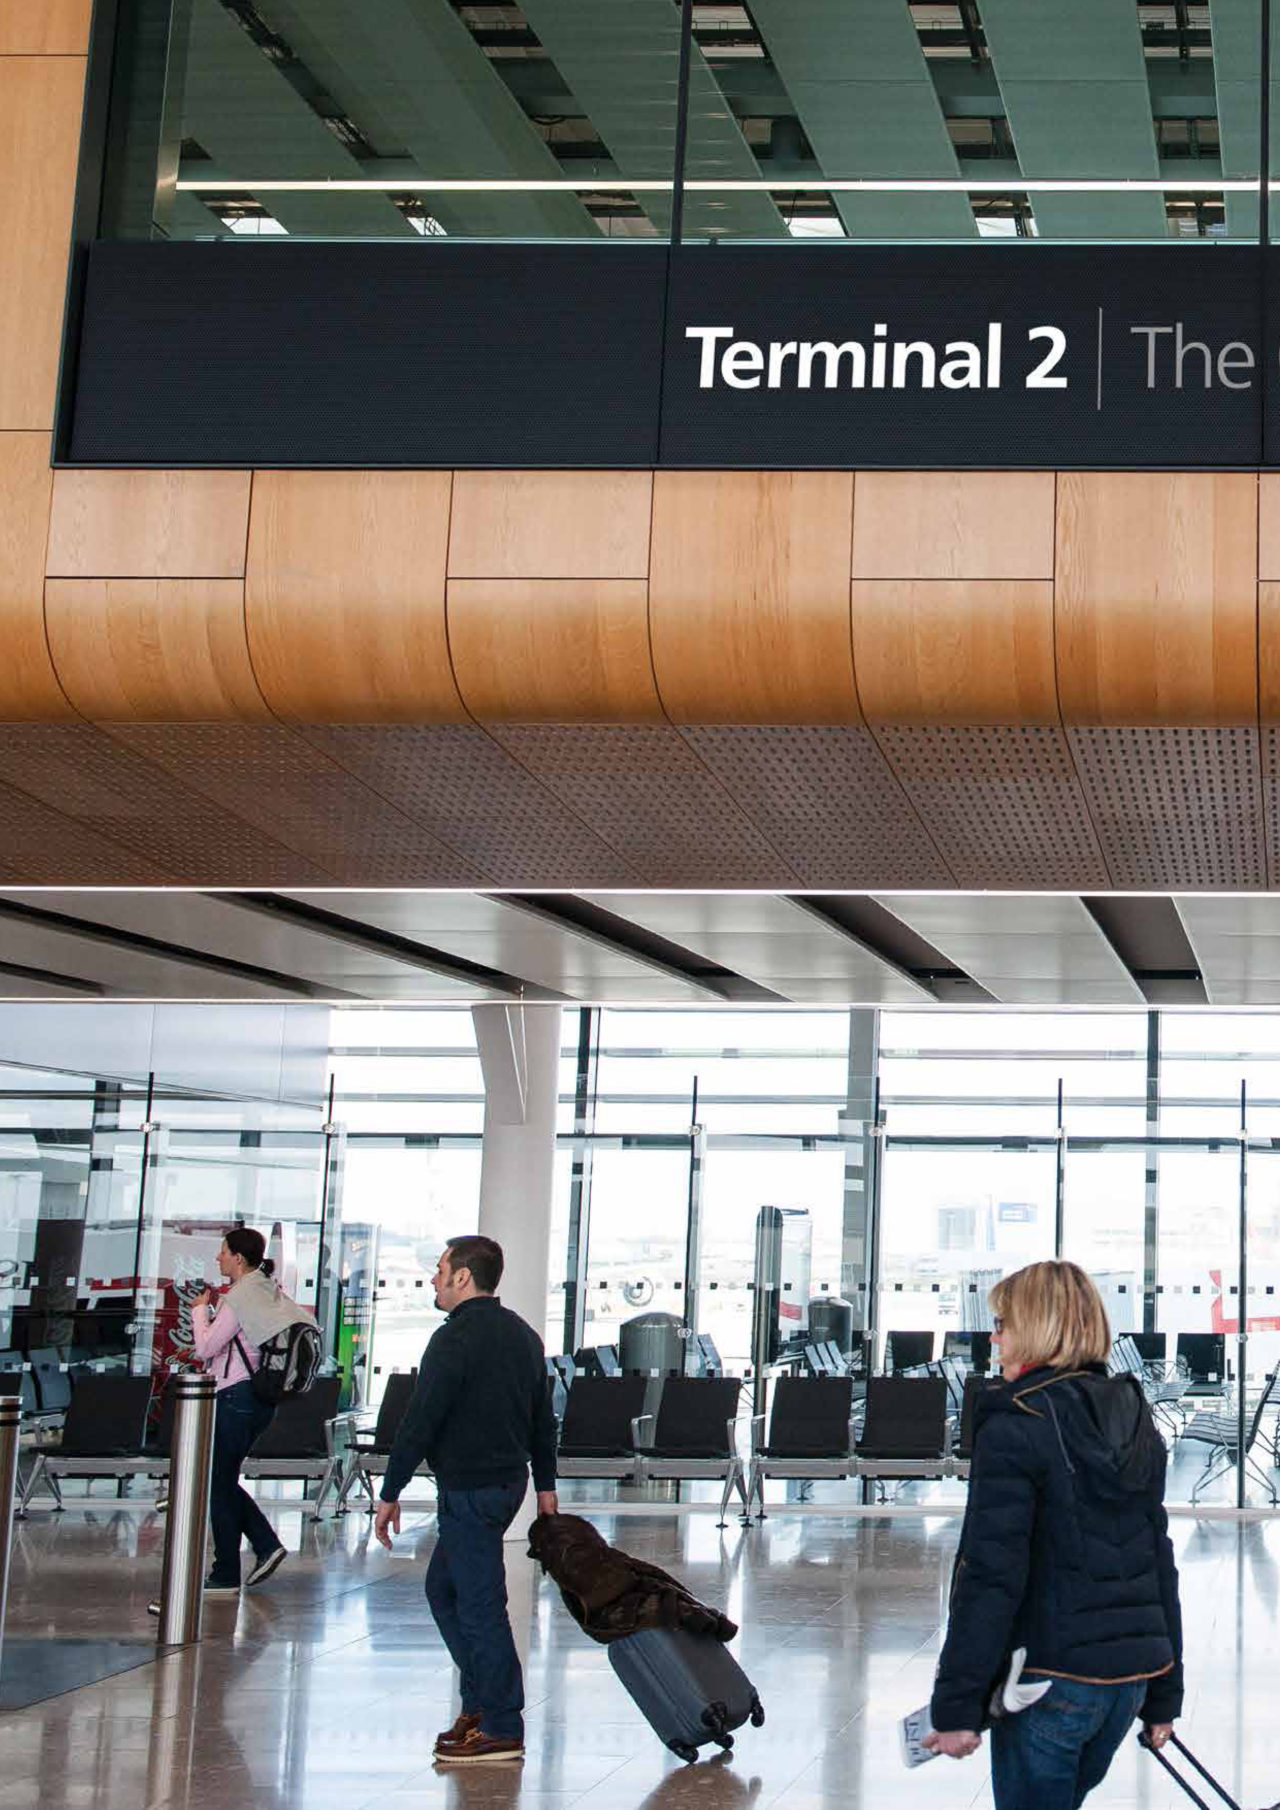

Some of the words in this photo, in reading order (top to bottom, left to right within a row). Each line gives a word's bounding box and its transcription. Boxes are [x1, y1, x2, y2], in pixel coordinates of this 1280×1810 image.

[685, 322, 1003, 390] Terminal
[1026, 326, 1068, 389] 2
[1130, 322, 1255, 389] The
